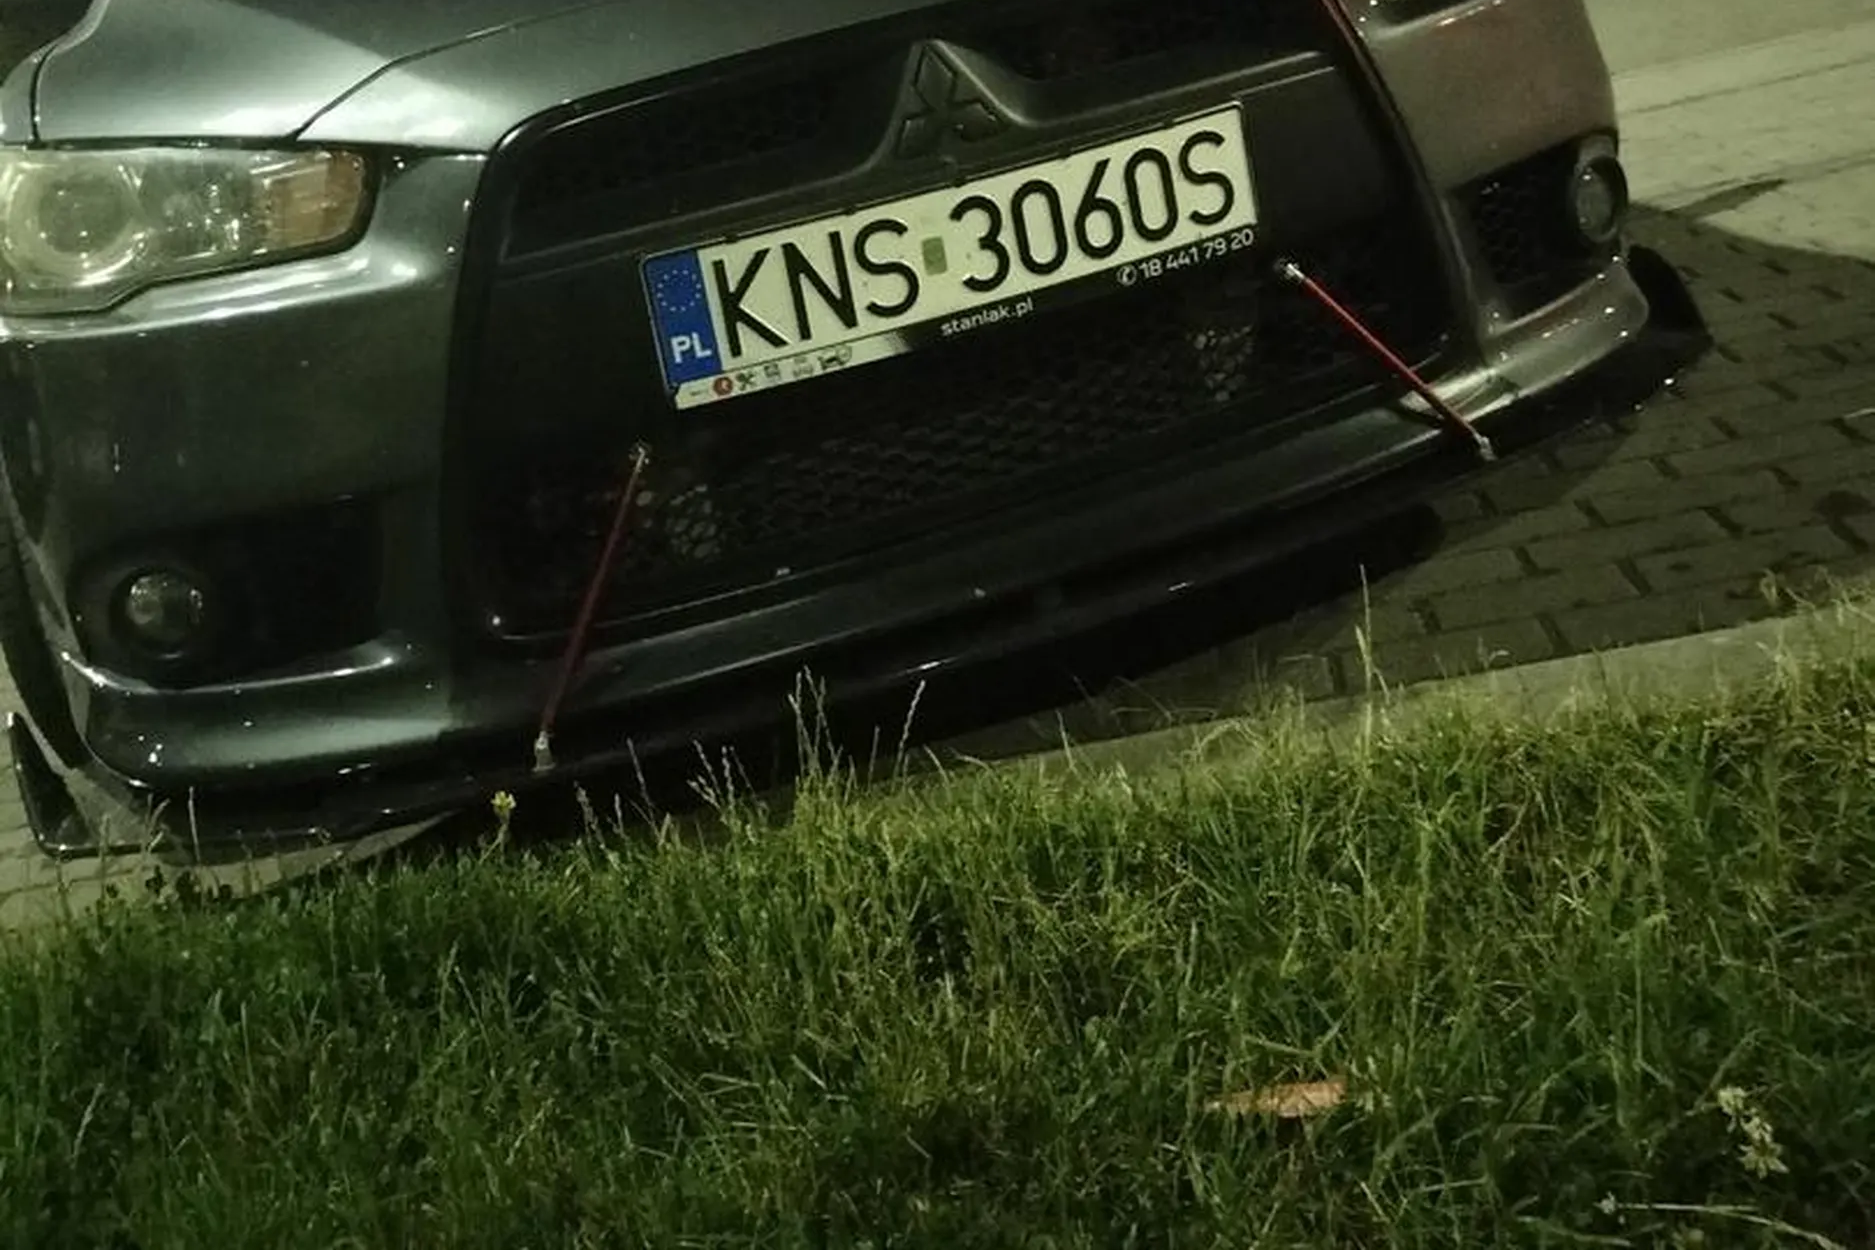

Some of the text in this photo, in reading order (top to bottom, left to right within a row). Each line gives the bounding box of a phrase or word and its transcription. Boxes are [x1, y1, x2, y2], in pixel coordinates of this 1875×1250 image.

[711, 130, 1235, 358] KNS 3060S
[1139, 229, 1254, 279] 18 441 79 20
[670, 330, 713, 365] PL
